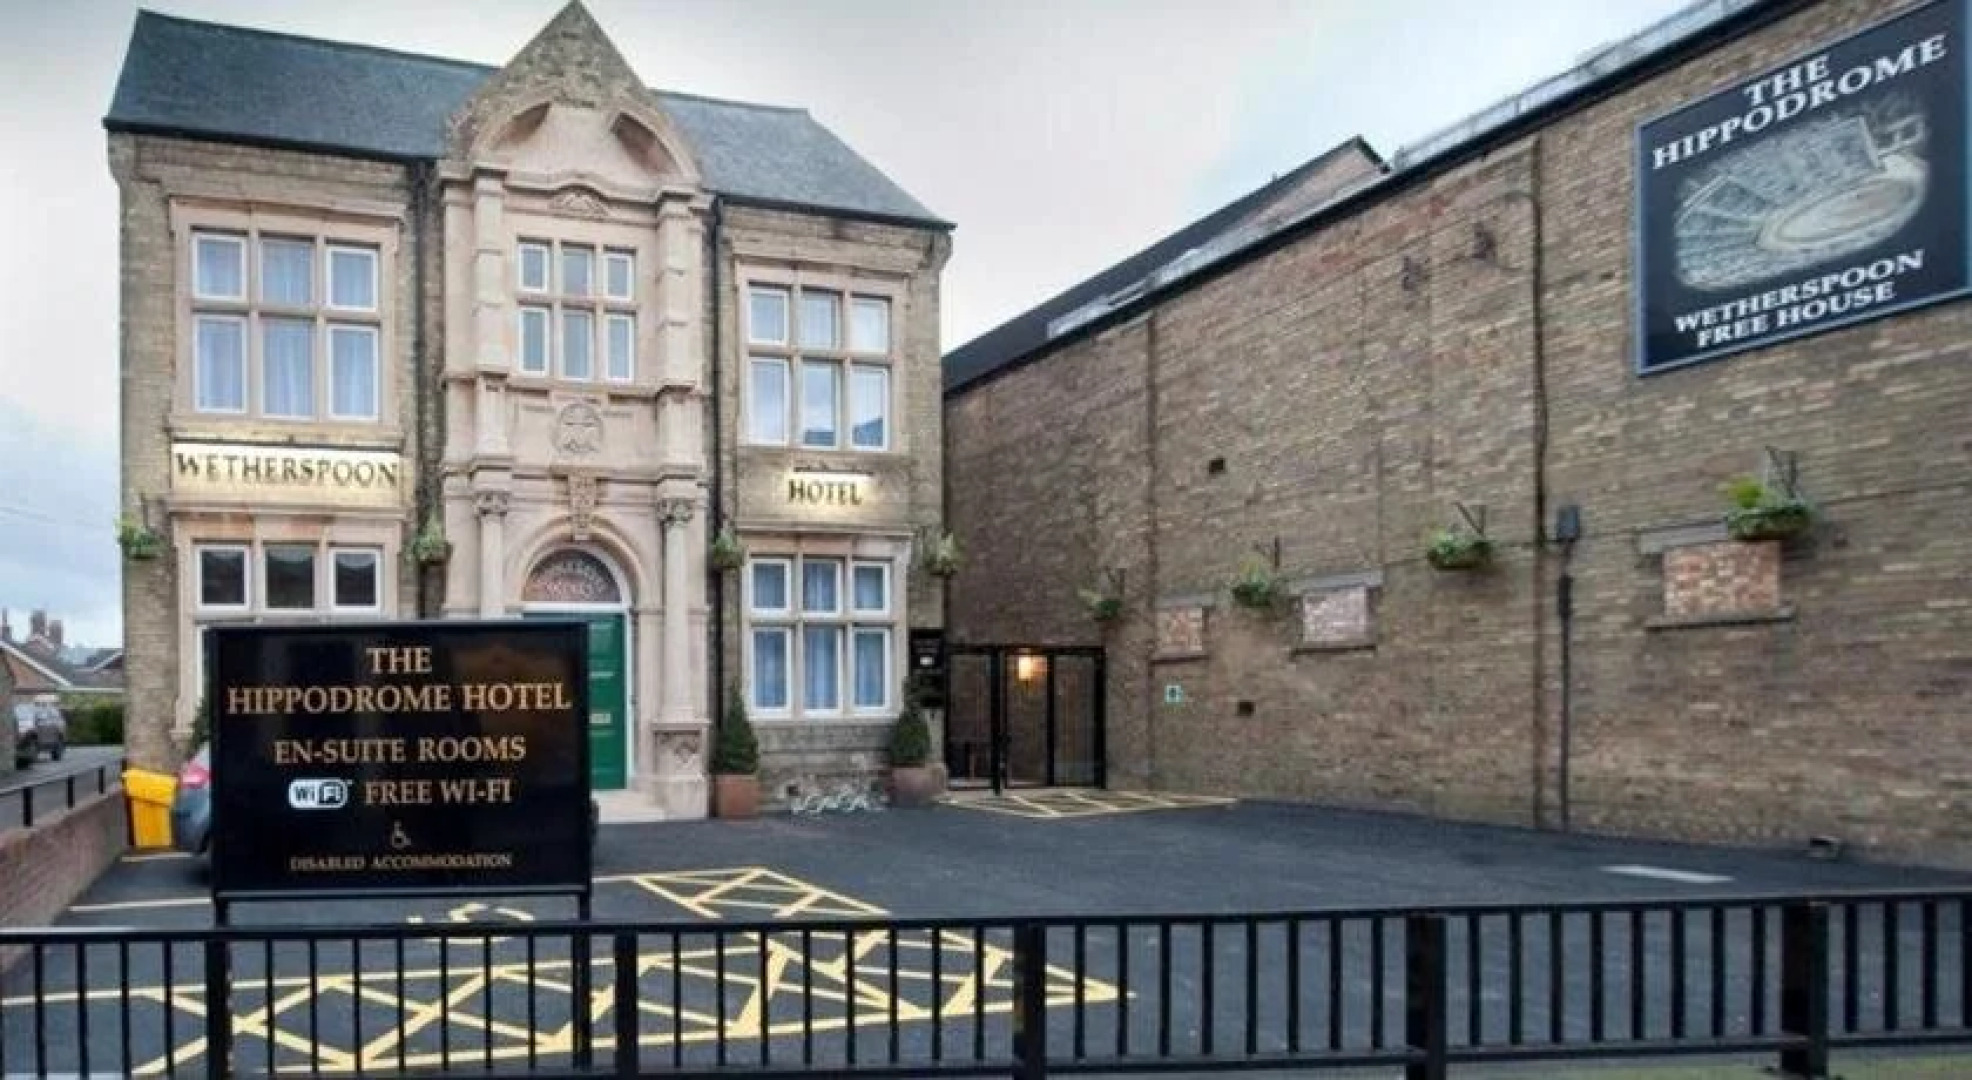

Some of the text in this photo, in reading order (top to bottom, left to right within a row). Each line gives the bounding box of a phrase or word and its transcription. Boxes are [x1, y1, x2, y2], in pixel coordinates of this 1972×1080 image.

[1745, 55, 1830, 106] THE
[1652, 34, 1947, 169] HIPPODROME
[1675, 249, 1925, 332] WETHERSPOON
[1697, 281, 1896, 348] FREE HOUSE
[175, 452, 398, 487] WETHERSPOON
[788, 479, 863, 506] HOTEL
[366, 647, 432, 674] THE
[227, 682, 572, 715] HIPPODROME HOTEL
[274, 737, 526, 764] EN-SUITE ROOMS
[365, 780, 433, 804] FREE
[440, 779, 513, 803] WI-FI
[290, 854, 512, 871] DISABLED ACCOMMODATION
